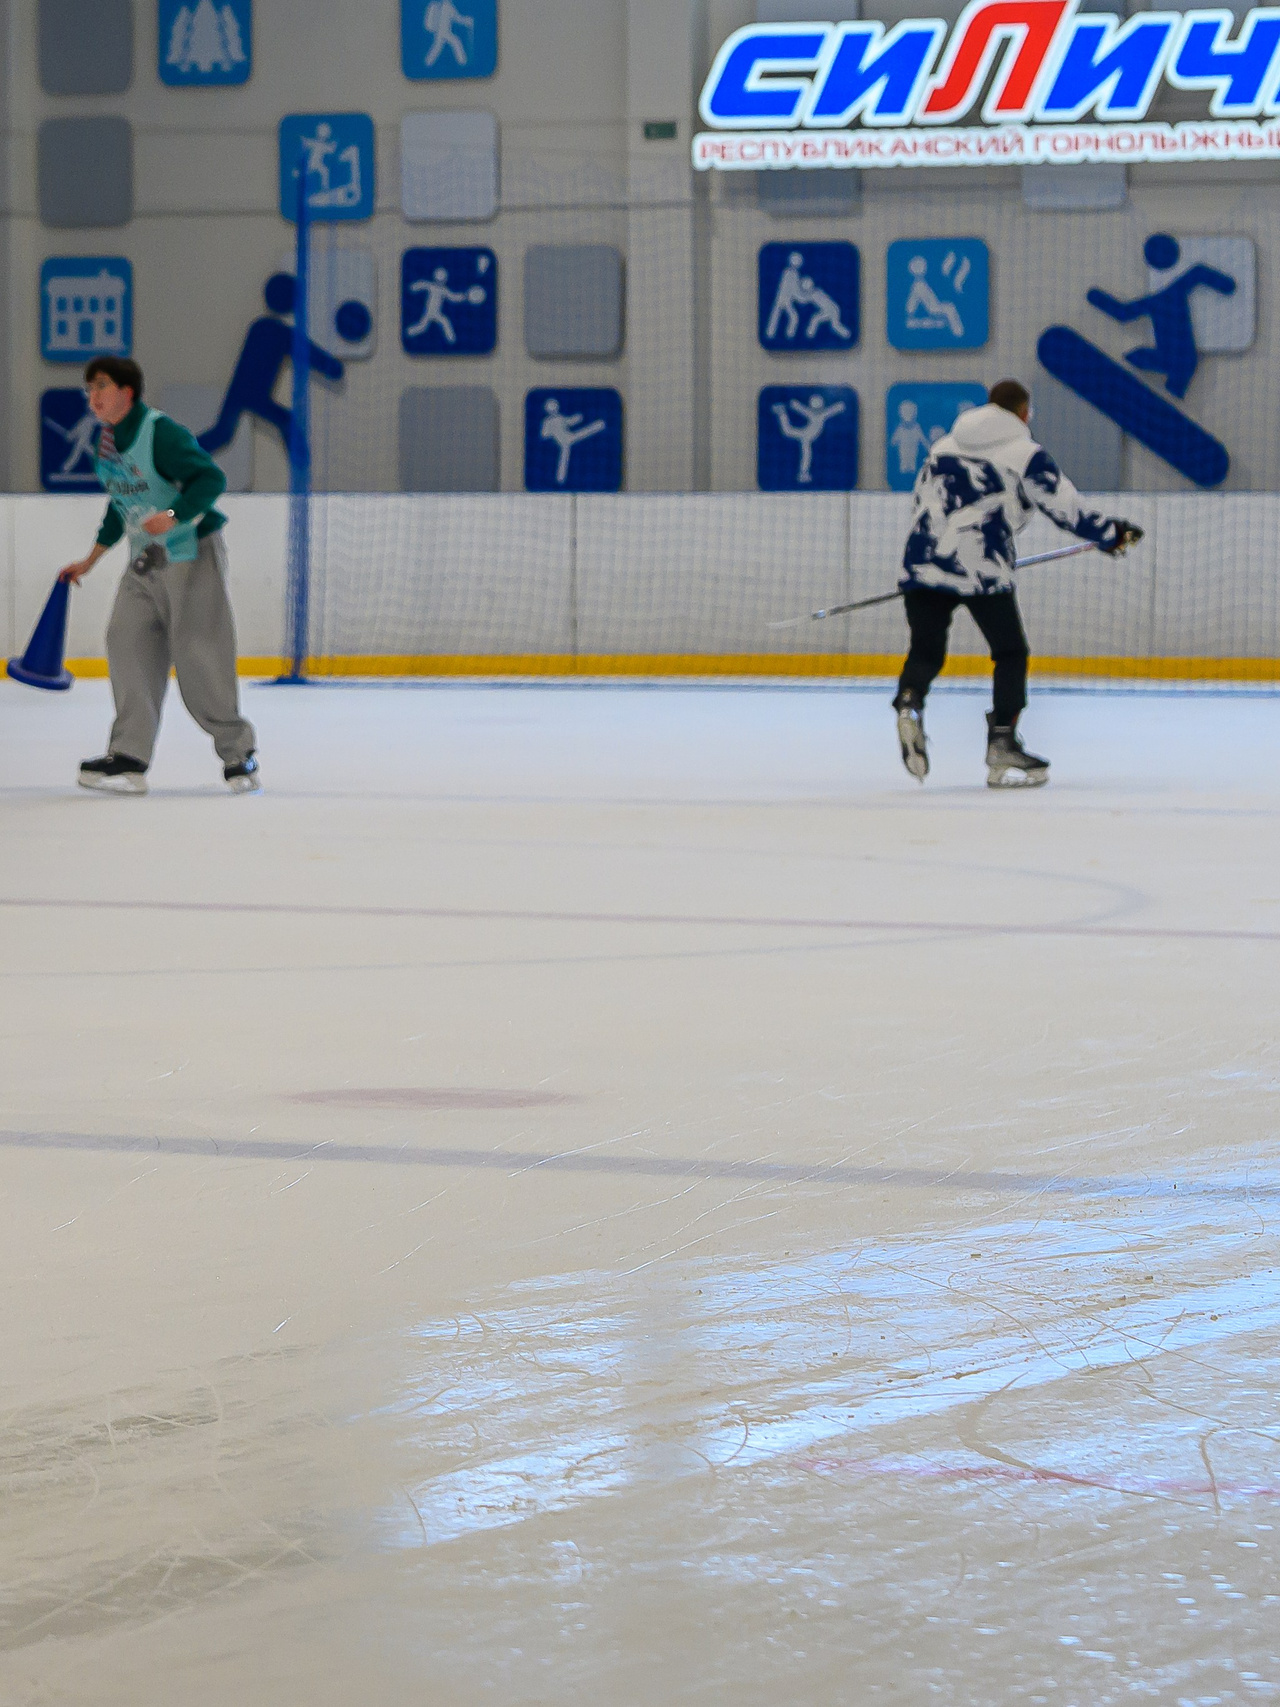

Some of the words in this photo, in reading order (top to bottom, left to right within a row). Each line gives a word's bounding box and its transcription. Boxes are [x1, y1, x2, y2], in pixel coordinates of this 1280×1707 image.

[706, 0, 1280, 120] СИЛИЧ
[699, 129, 1024, 161] РЕСПУБЛИКАНСКИЙ
[1033, 129, 1280, 156] ГОРНОЛЫЖНЫ
